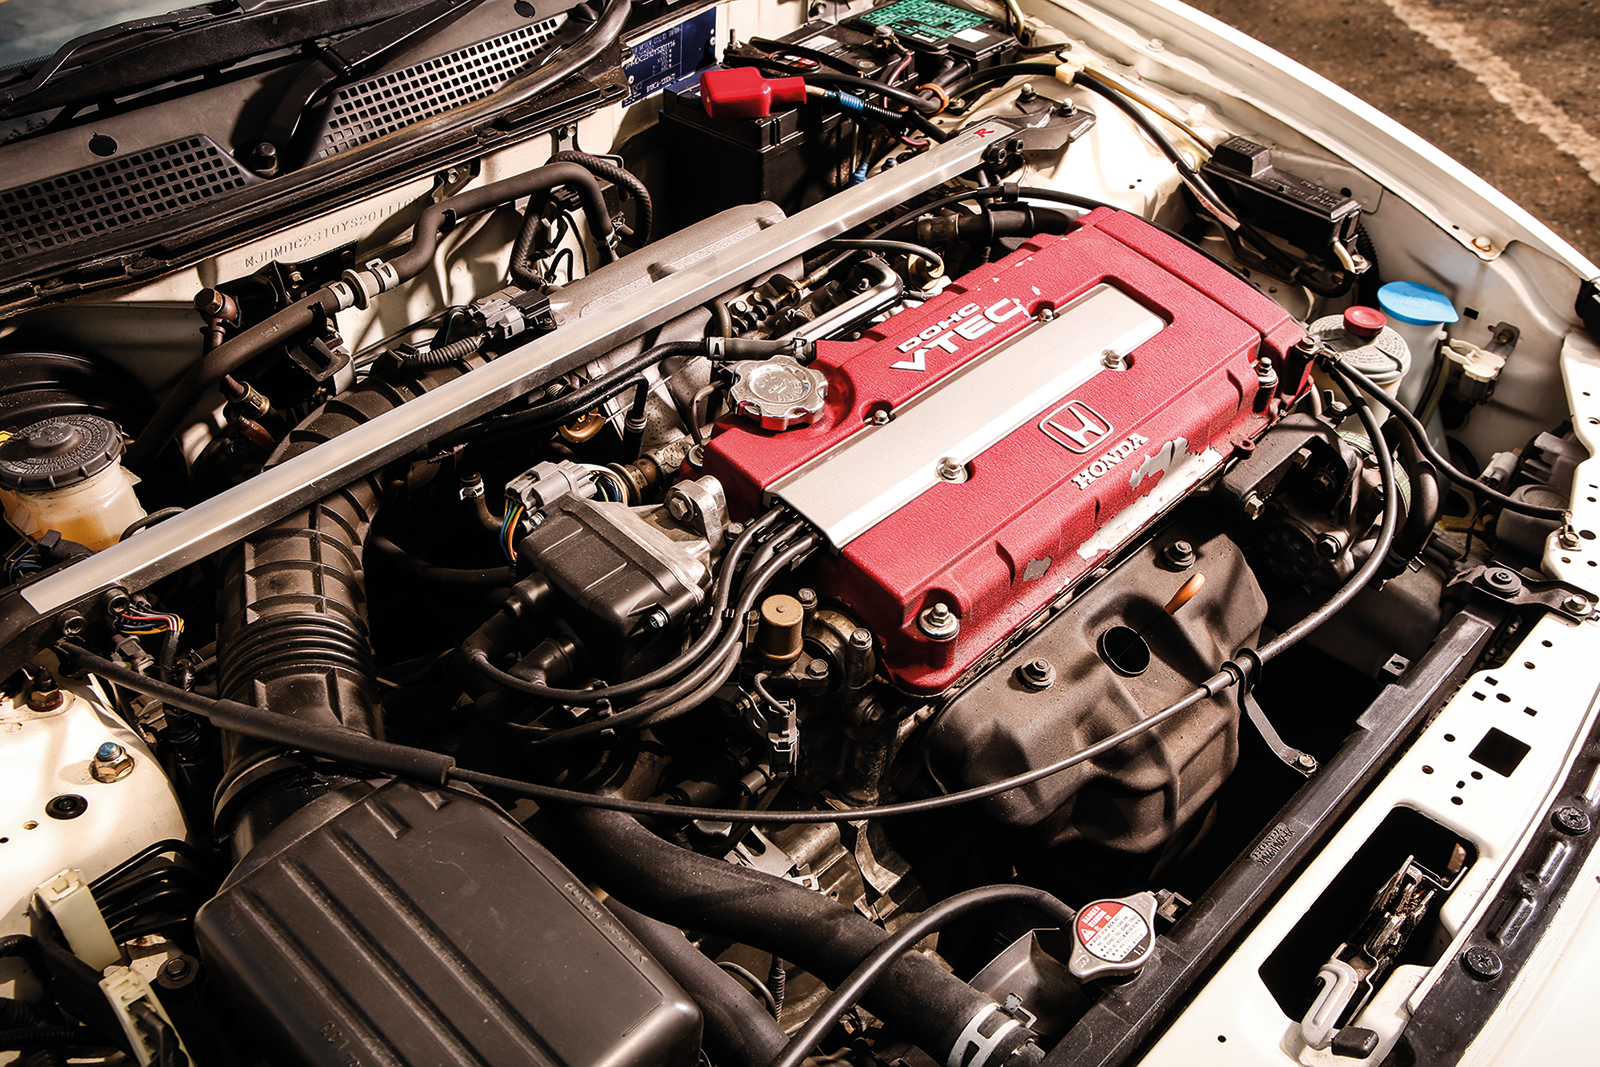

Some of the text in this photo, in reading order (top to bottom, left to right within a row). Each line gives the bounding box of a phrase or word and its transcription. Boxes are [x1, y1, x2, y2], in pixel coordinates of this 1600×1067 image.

[889, 298, 1024, 371] VTEC
[896, 302, 981, 353] DOHC
[1071, 432, 1150, 491] HONDA
[563, 882, 602, 920] HONDA
[1081, 905, 1102, 924] DANGER
[1133, 944, 1146, 956] 1.1
